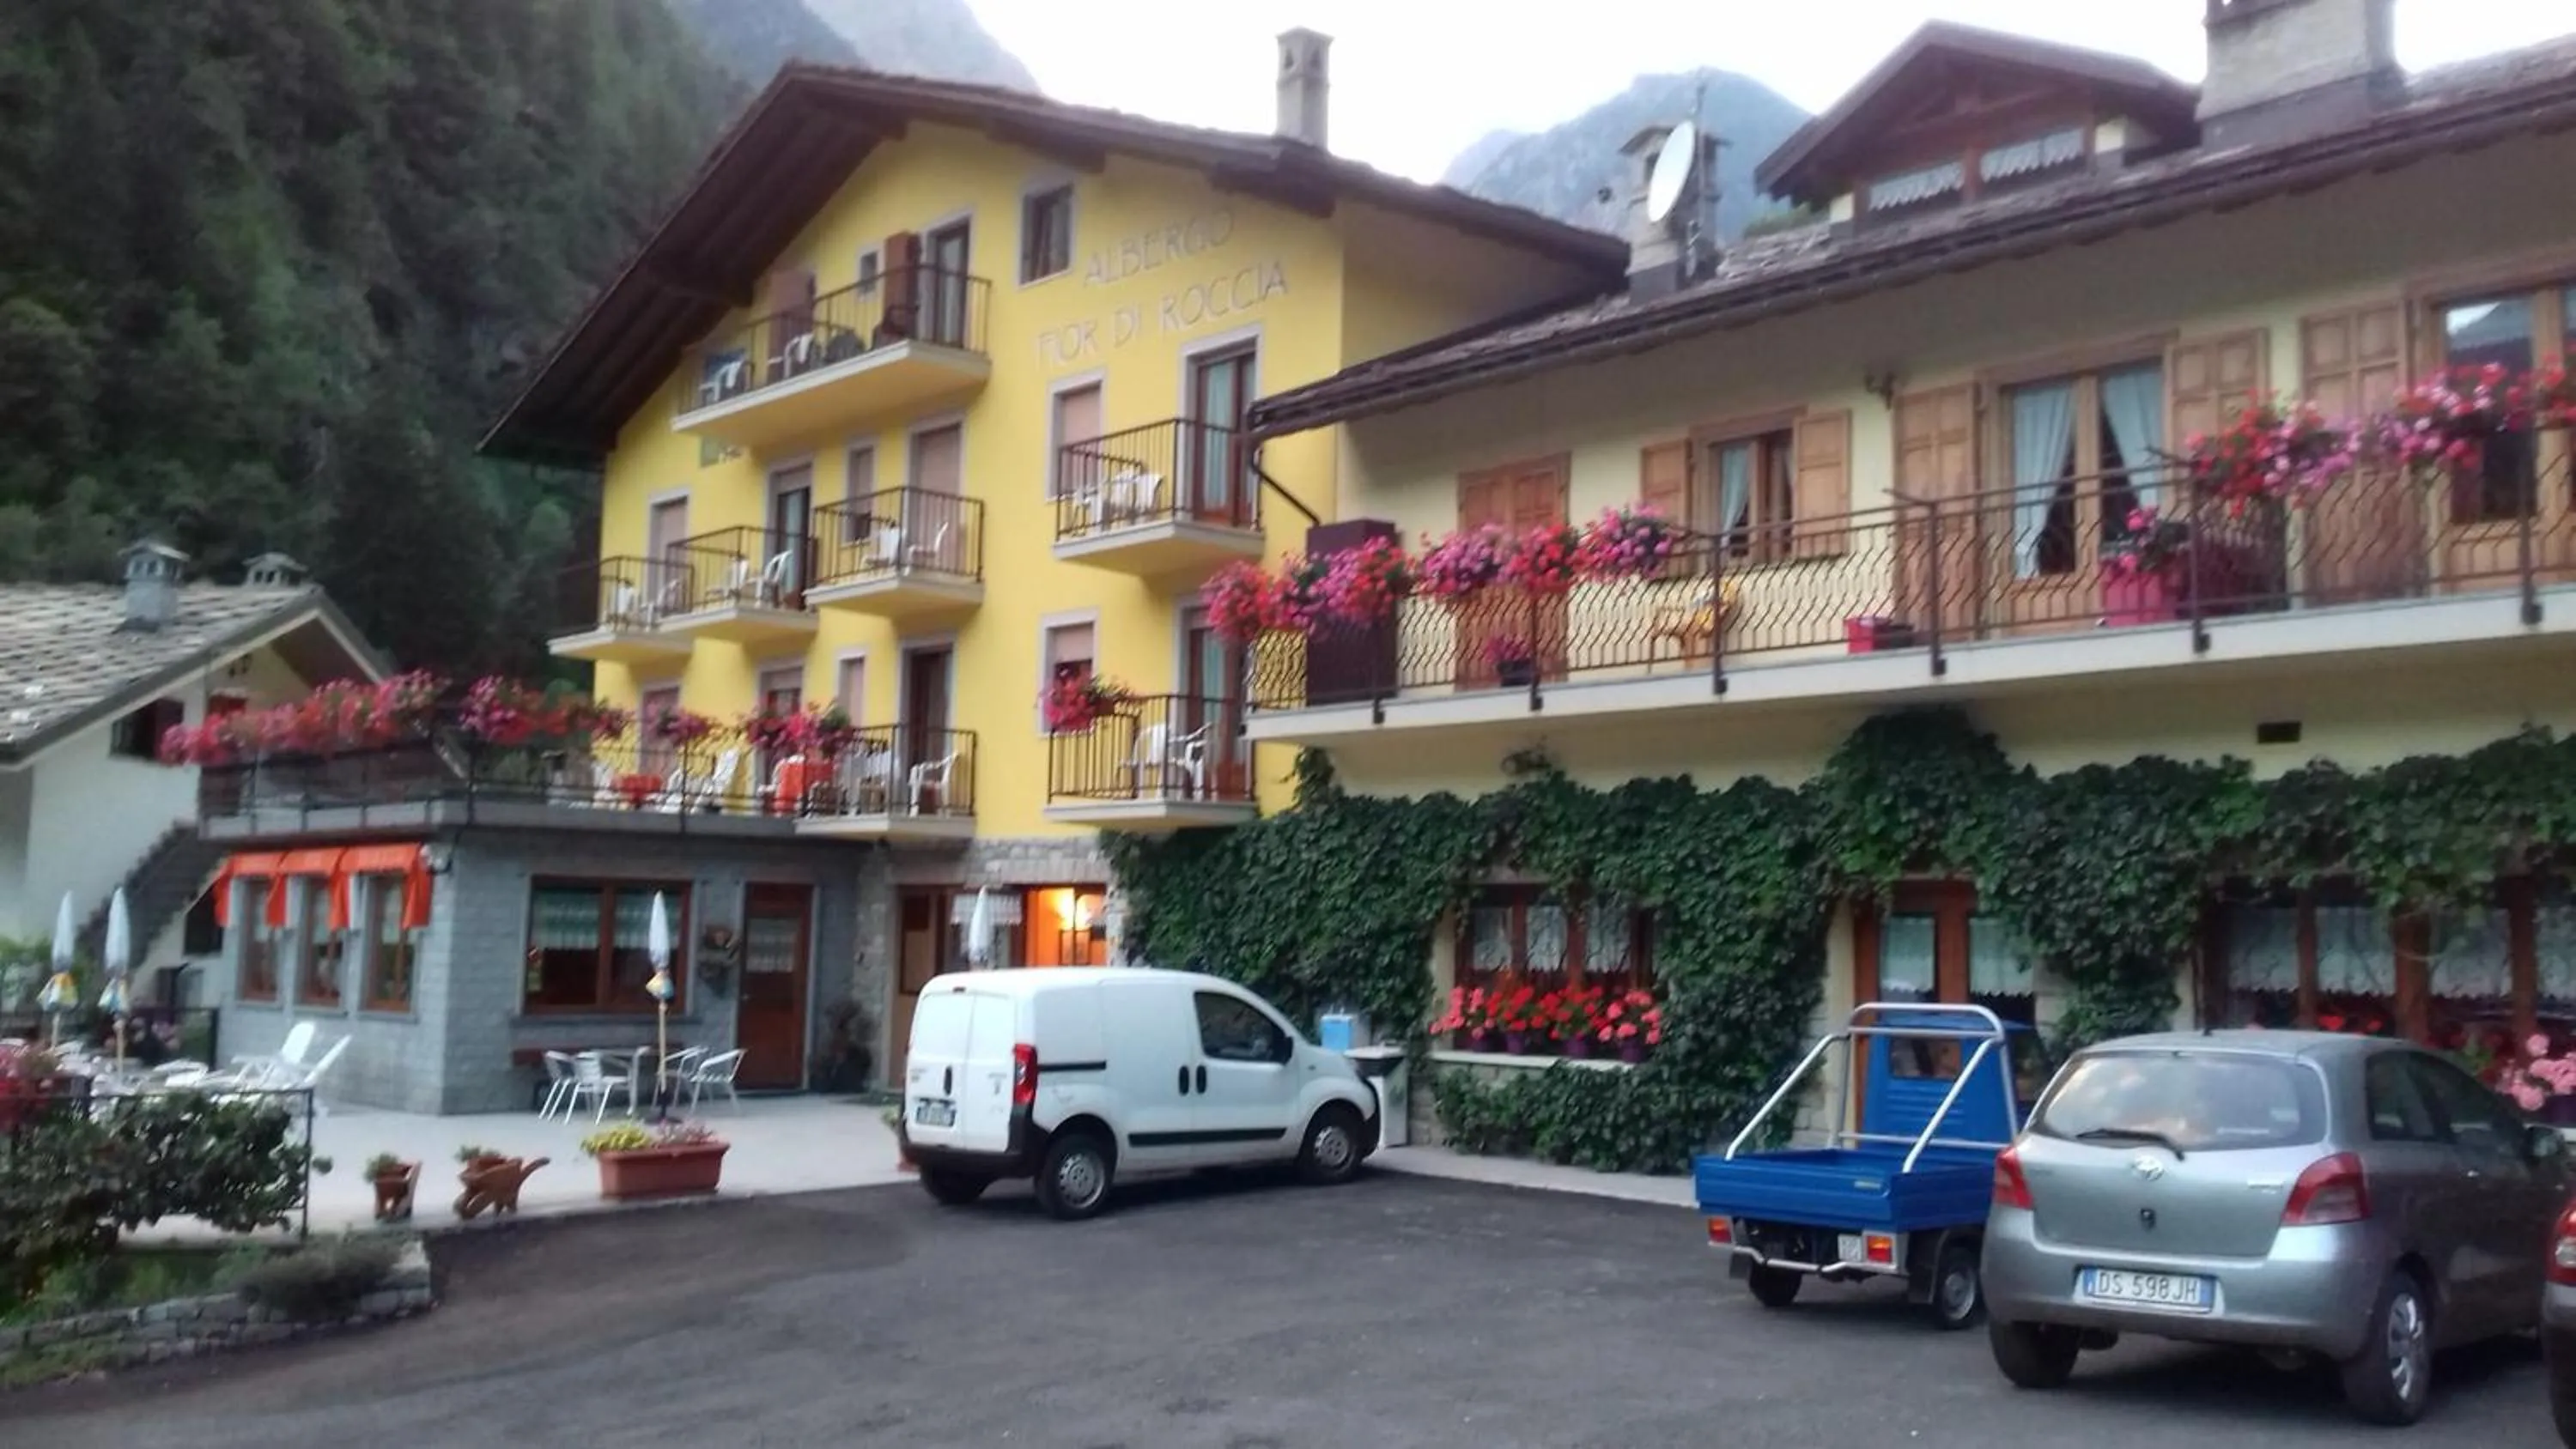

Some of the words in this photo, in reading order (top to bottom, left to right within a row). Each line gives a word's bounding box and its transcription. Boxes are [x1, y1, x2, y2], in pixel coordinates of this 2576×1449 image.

[1084, 208, 1235, 287] ALBERGO
[1037, 318, 1098, 370] FIOR
[1114, 304, 1140, 349] DI
[1161, 260, 1287, 330] ROCCIA
[2099, 1272, 2123, 1294] DS
